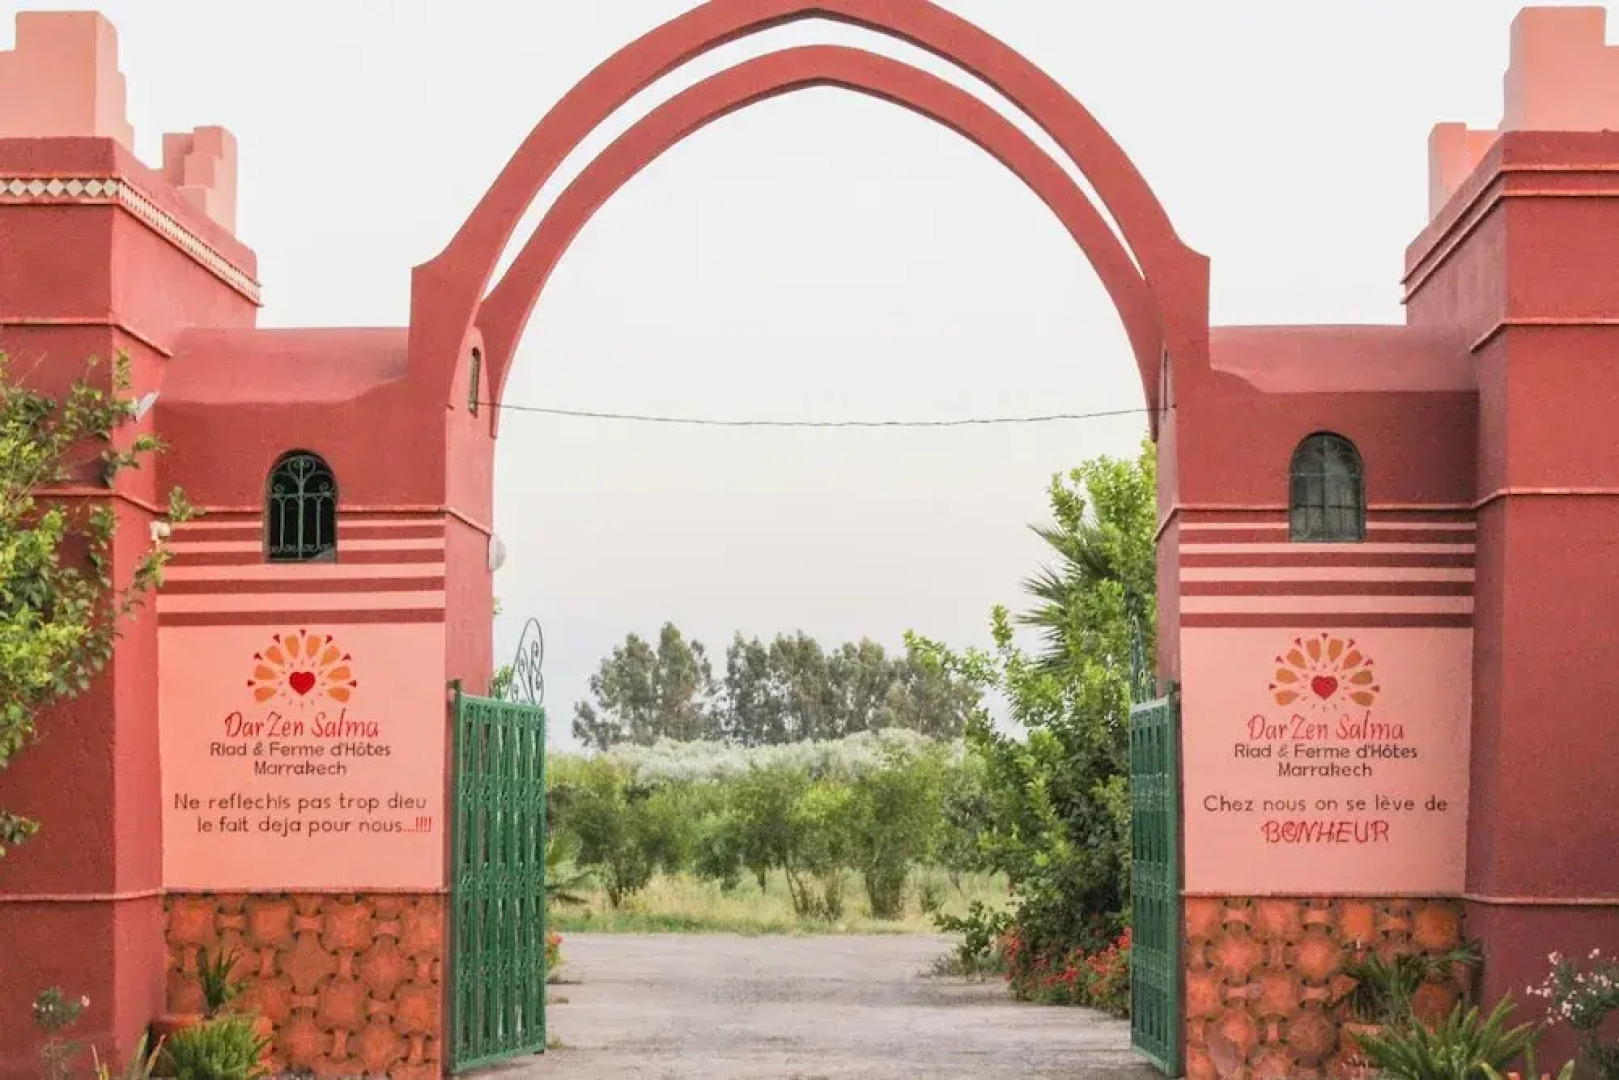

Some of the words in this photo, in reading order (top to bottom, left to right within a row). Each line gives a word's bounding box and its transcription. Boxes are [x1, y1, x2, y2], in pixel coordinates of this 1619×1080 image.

[311, 708, 379, 738] Salma
[1336, 711, 1404, 740] Salma
[210, 742, 247, 757] Riad
[253, 742, 263, 757] &
[269, 742, 324, 757] Ferme
[330, 742, 391, 757] d'Hôtes
[1234, 743, 1271, 759] Riad
[1277, 744, 1288, 758] &
[1294, 743, 1350, 759] Ferme
[1356, 743, 1418, 759] d'Hôtes
[254, 761, 347, 775] Marrakech
[1278, 762, 1372, 777] Marrakech
[174, 793, 200, 810] Ne
[208, 793, 291, 810] reflechis
[298, 796, 331, 813] pas
[339, 793, 380, 814] trop
[388, 793, 426, 809] dieu
[1204, 795, 1254, 812] Chez
[1263, 798, 1306, 812] nous
[1315, 798, 1338, 811] on
[1346, 798, 1366, 811] se
[1375, 794, 1415, 811] lève
[1425, 794, 1448, 811] de
[197, 816, 213, 833] le
[219, 816, 249, 833] fait
[258, 816, 301, 837] deja
[308, 820, 351, 837] pour
[1260, 820, 1390, 843] BONHEUR
